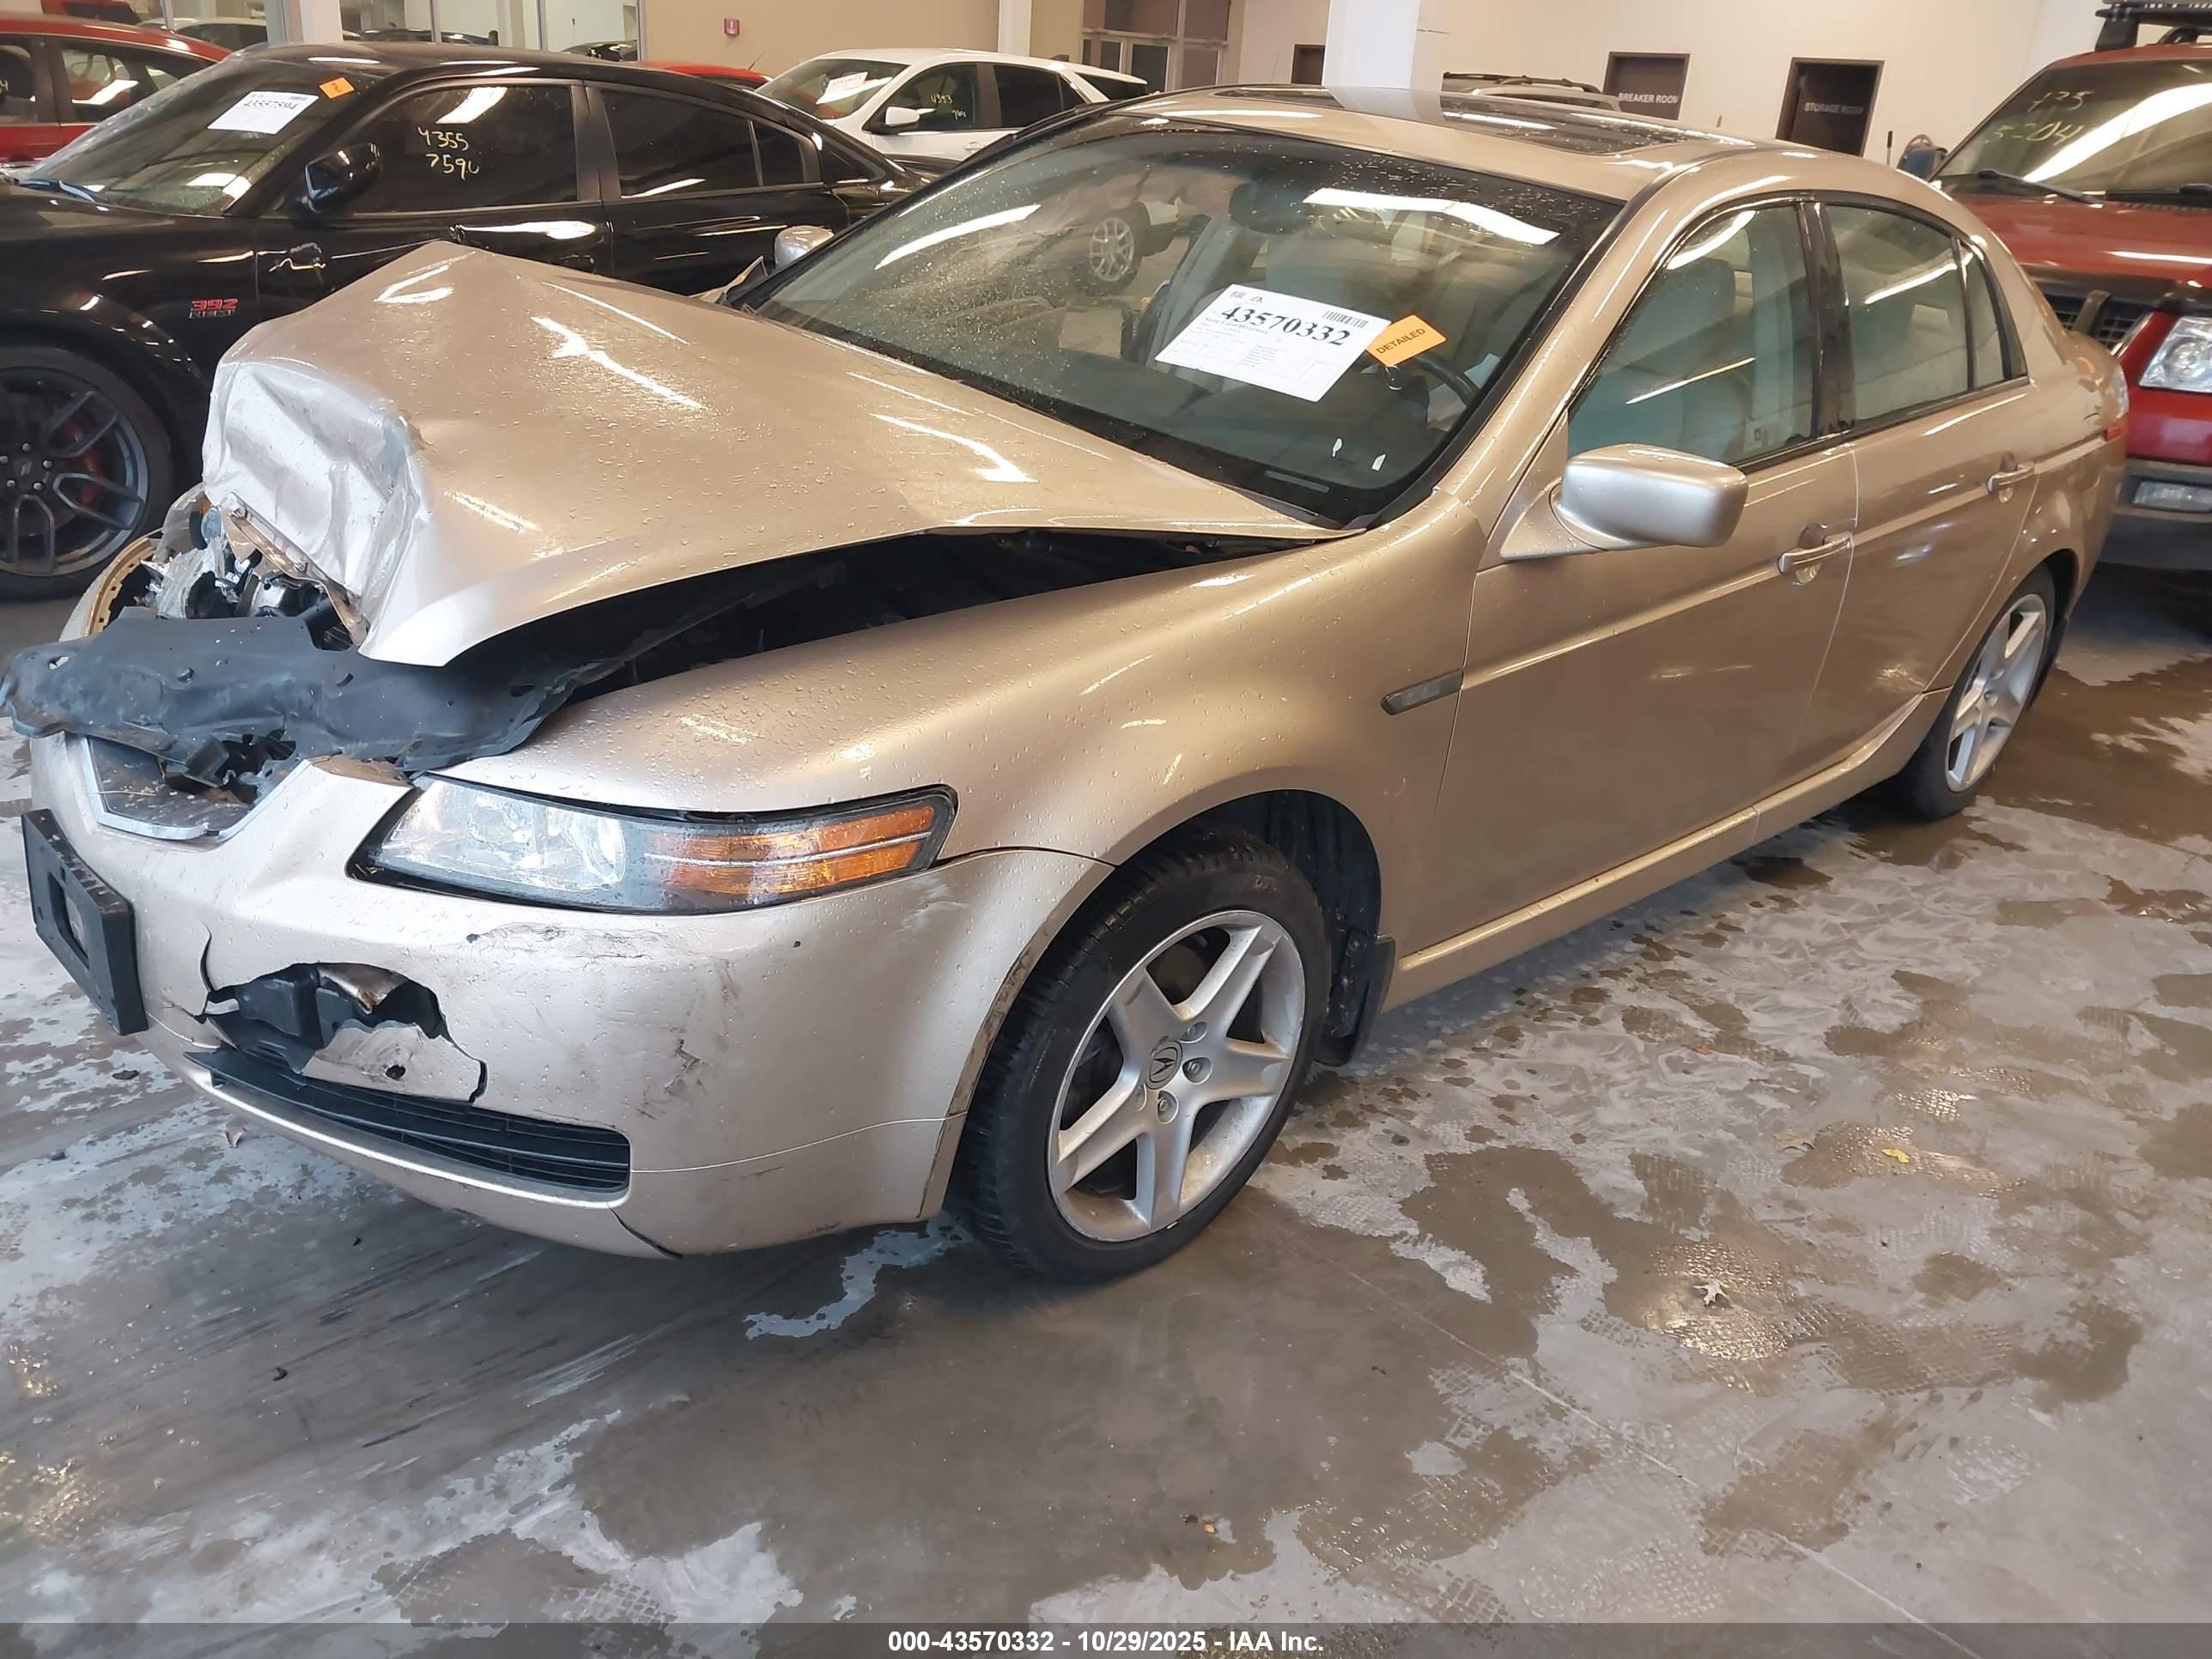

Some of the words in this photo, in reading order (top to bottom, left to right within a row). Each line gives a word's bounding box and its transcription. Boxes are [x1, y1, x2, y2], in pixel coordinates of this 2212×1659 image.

[1618, 92, 1654, 103] BREAKER
[416, 126, 469, 151] 4355
[191, 298, 239, 310] 392
[1220, 305, 1352, 346] 43570332
[1376, 328, 1426, 355] DETAILED
